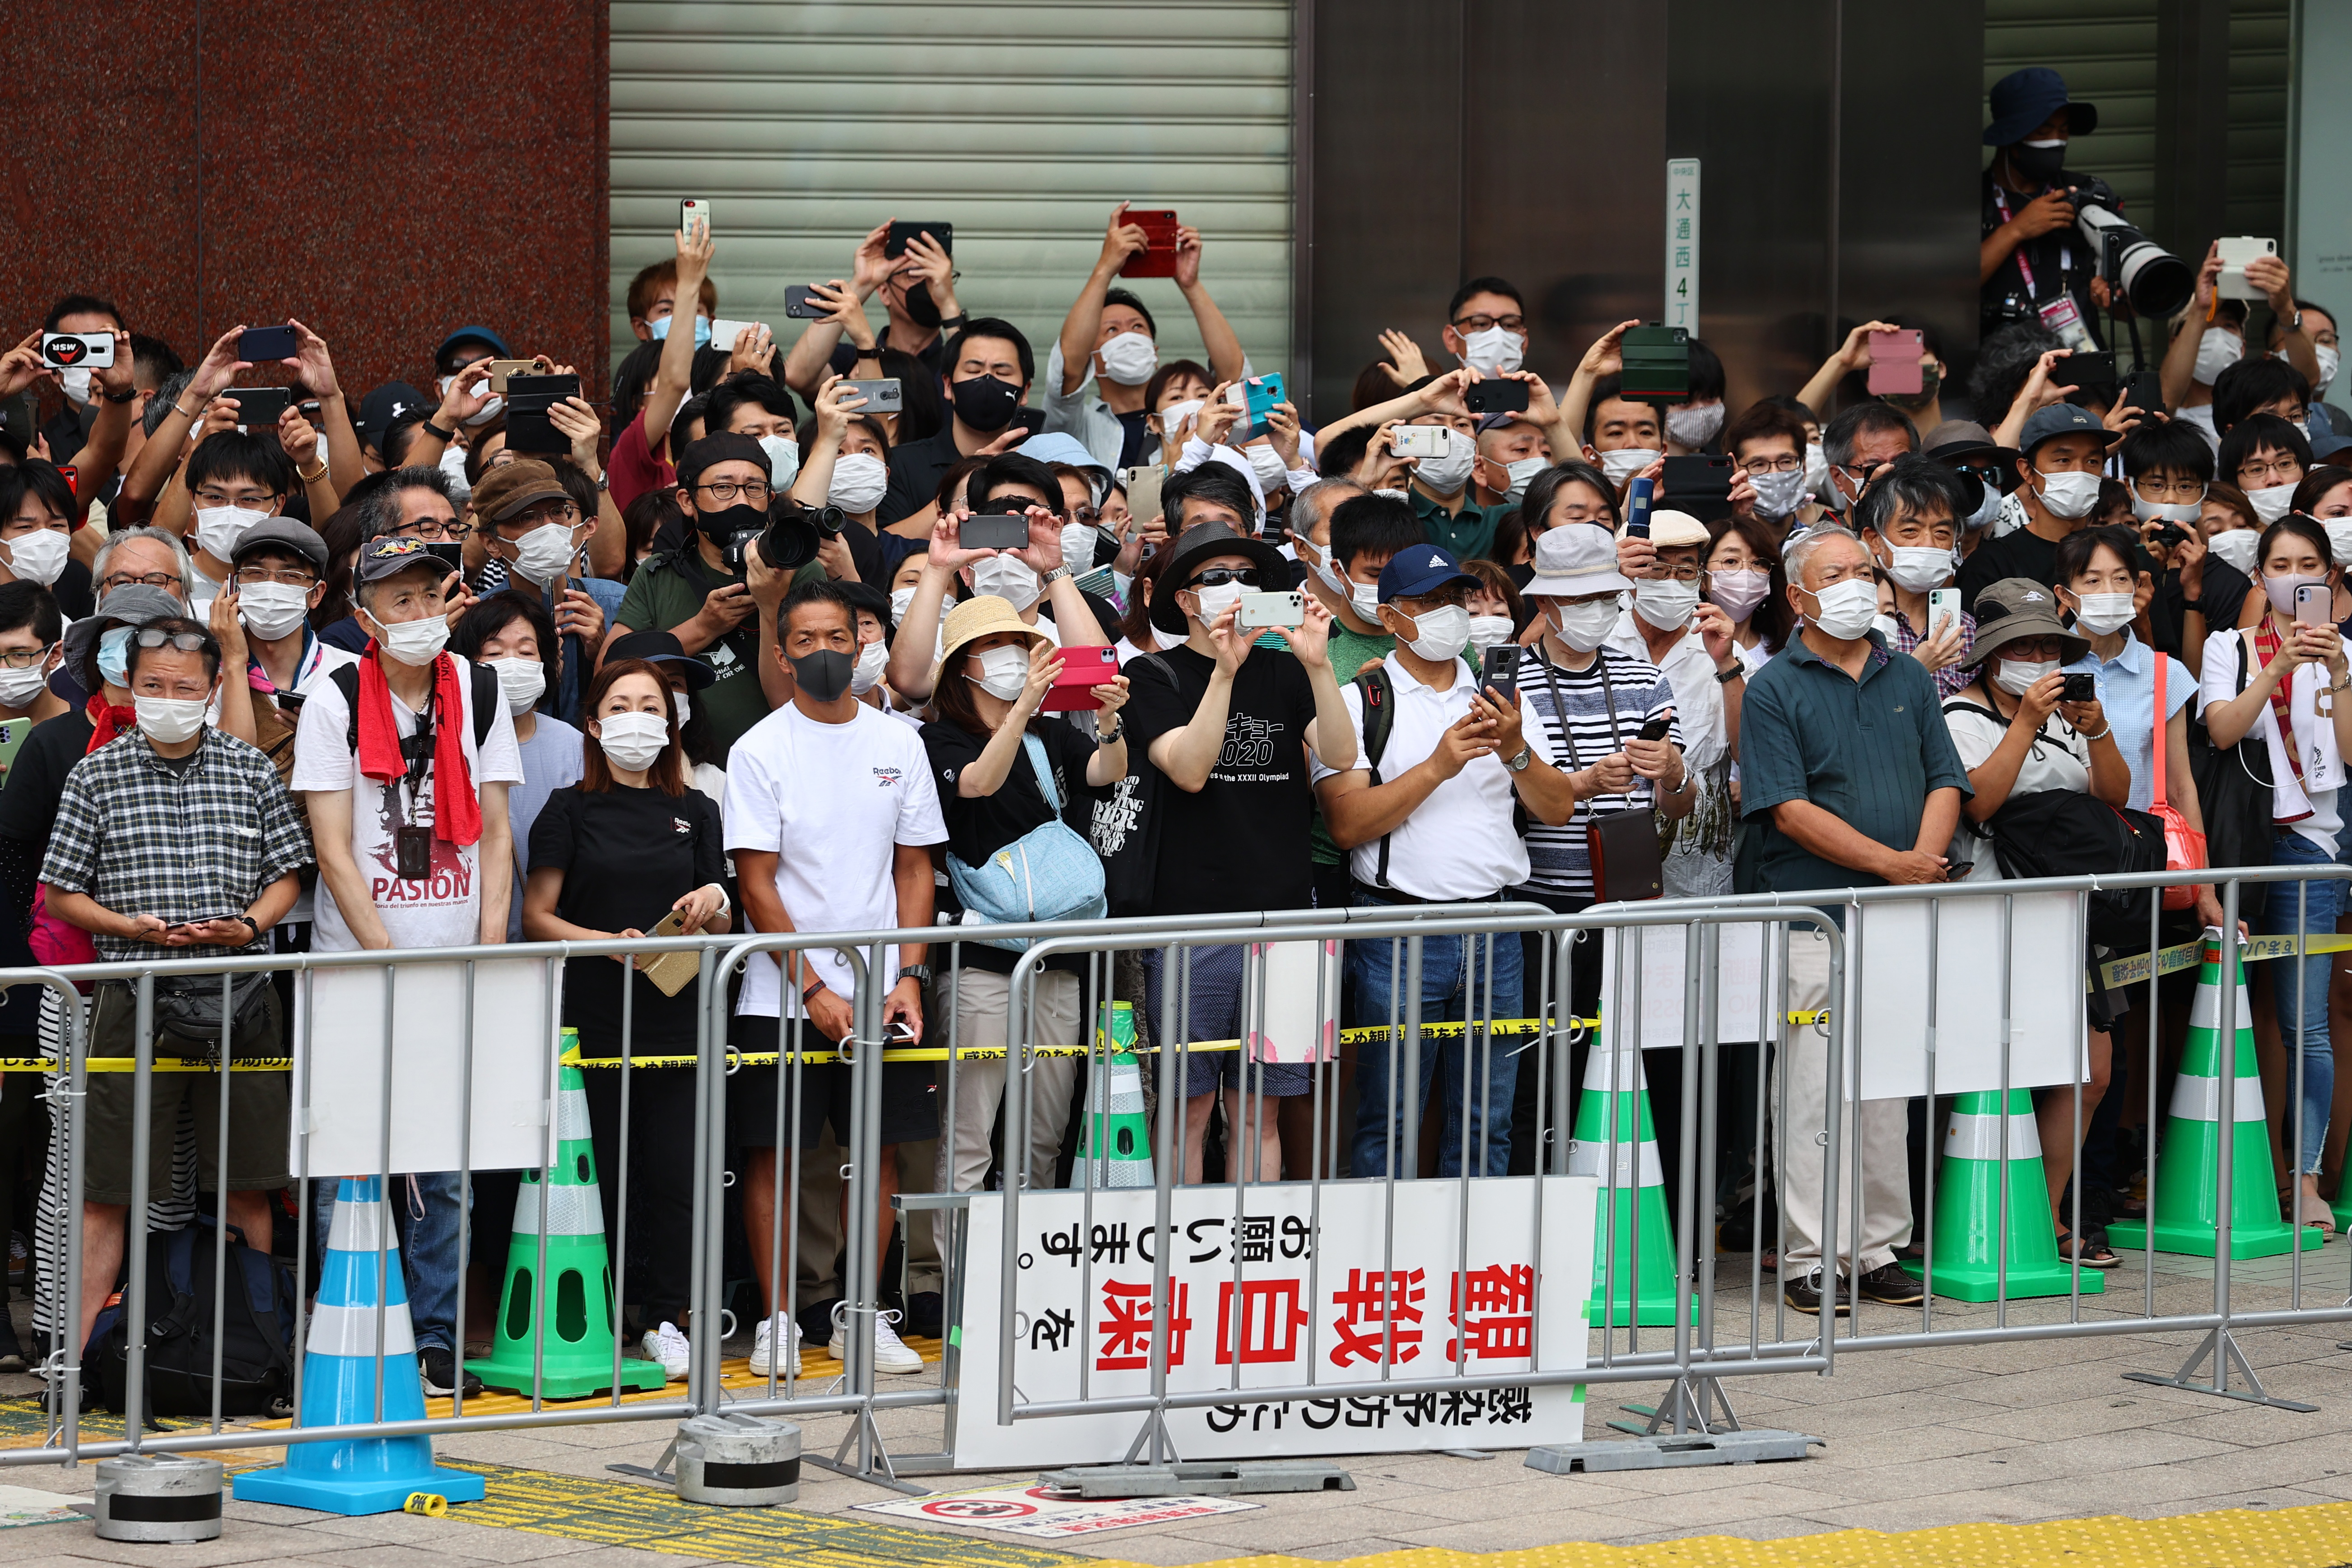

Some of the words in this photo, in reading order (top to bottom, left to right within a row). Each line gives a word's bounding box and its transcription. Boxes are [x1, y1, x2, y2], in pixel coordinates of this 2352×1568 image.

[1225, 712, 1284, 740] キョー
[1215, 740, 1273, 766] 020
[1224, 774, 1235, 782] the
[1259, 772, 1289, 782] Olympiad
